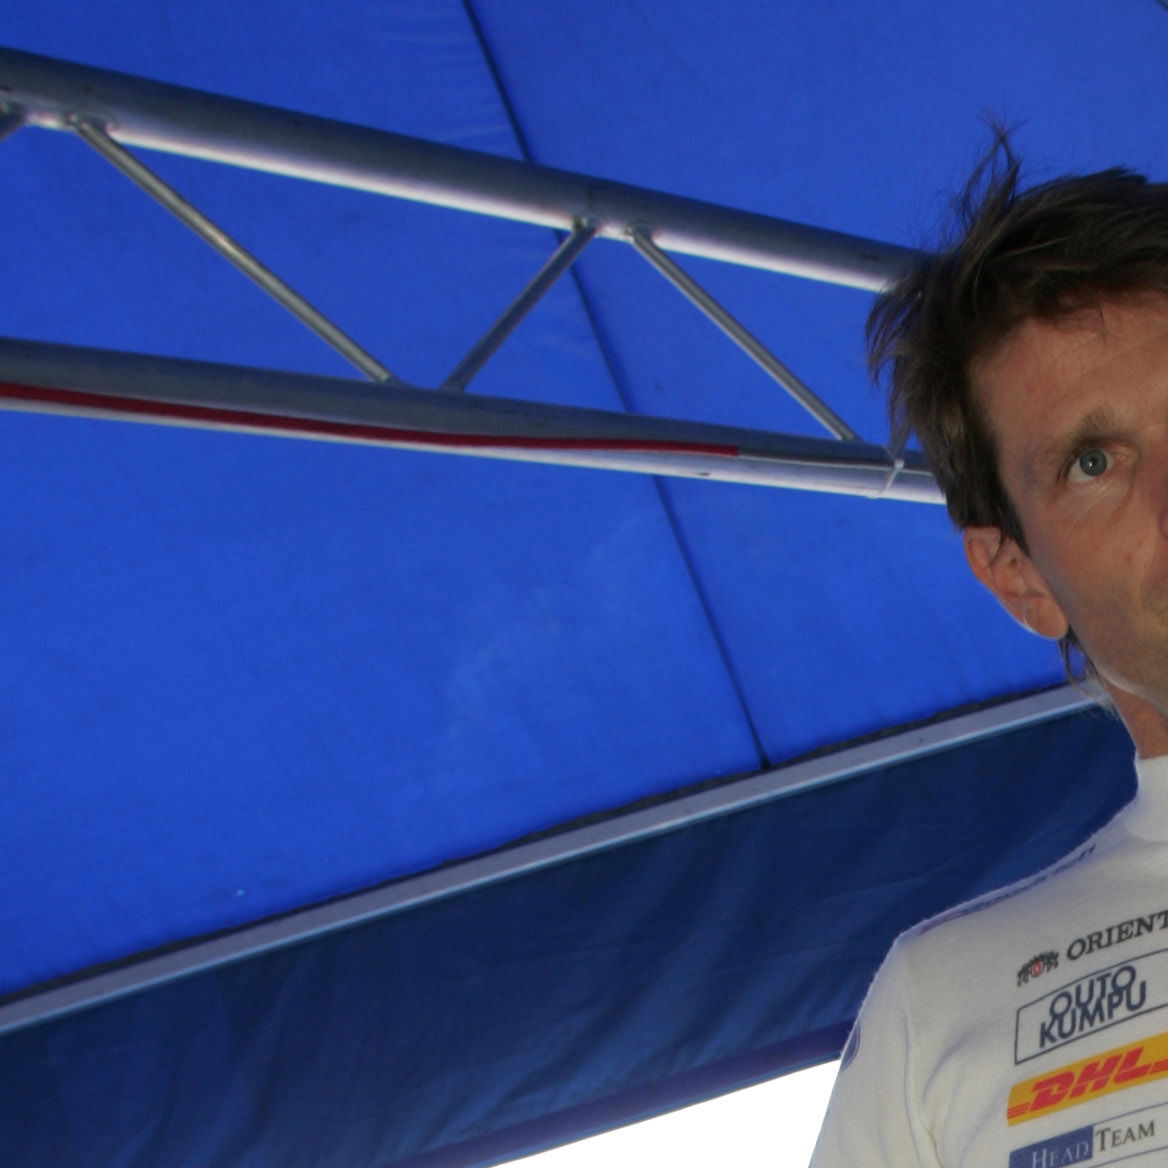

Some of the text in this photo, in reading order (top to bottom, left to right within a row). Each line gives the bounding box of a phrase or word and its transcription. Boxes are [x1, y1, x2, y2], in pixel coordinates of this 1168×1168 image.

[1039, 981, 1147, 1049] KUMPU
[1049, 966, 1136, 1022] OUTO
[1030, 1046, 1154, 1112] DHL
